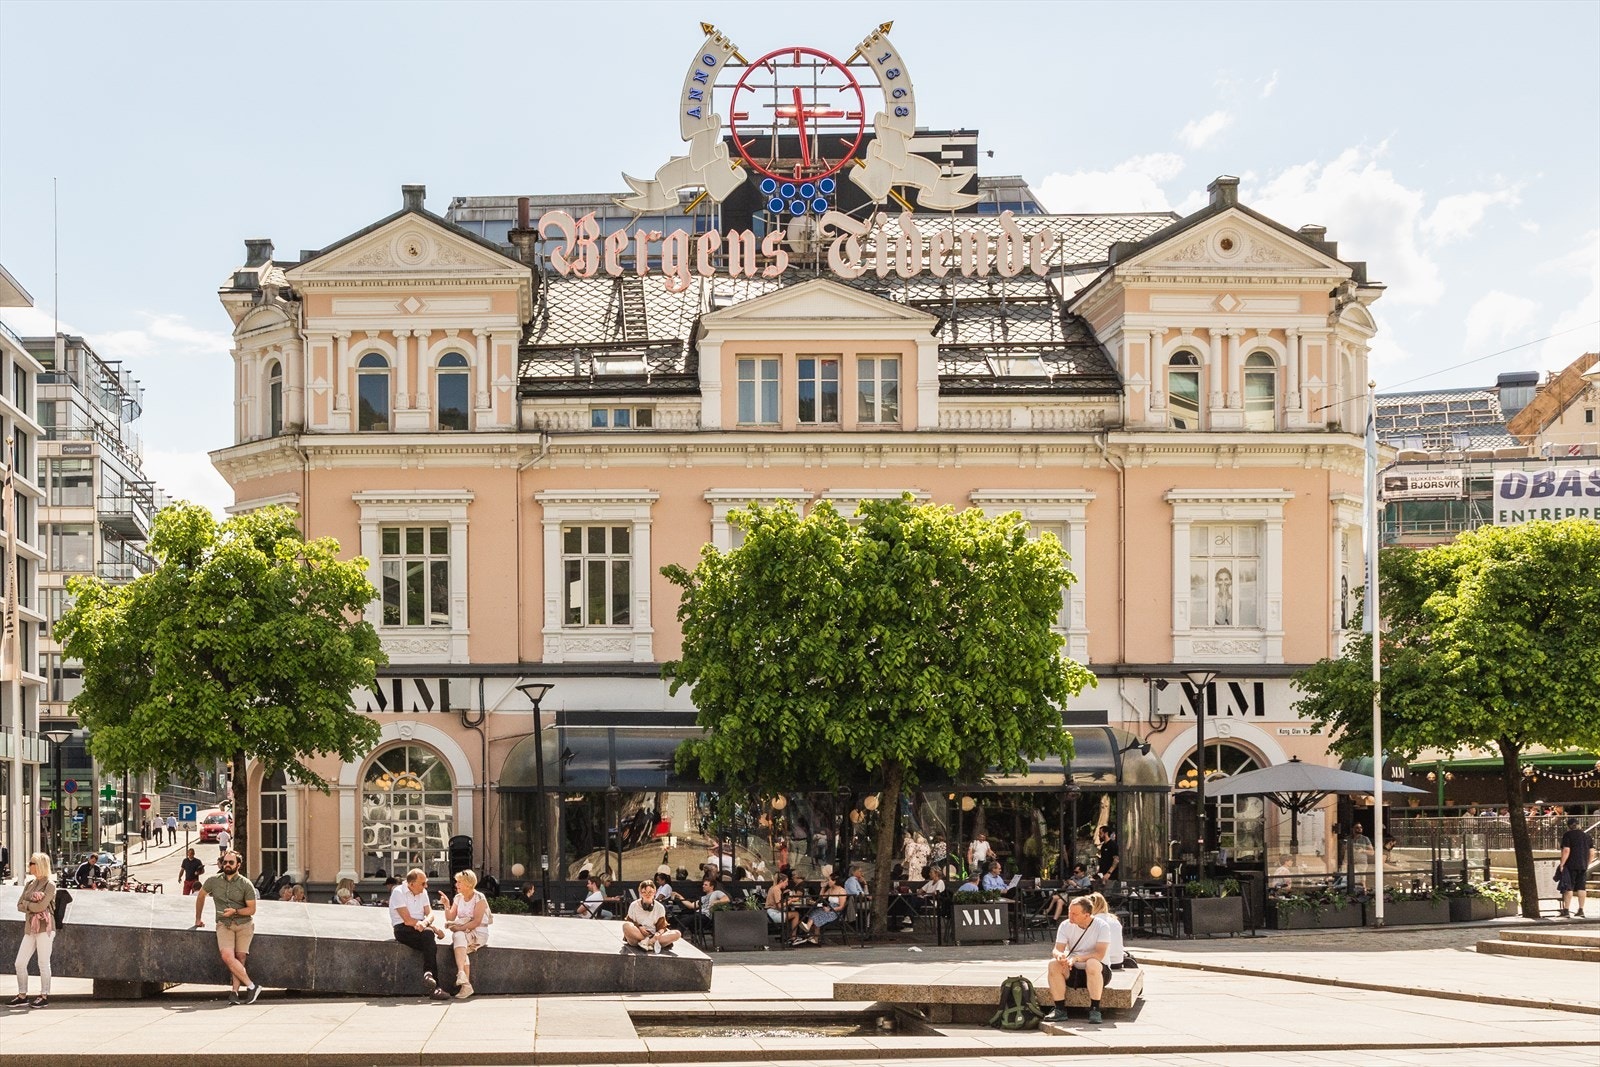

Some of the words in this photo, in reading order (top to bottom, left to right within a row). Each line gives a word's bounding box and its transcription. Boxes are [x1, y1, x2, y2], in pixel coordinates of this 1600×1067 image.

[687, 53, 717, 119] ANNO
[877, 52, 910, 117] 1868
[538, 210, 788, 293] Bergens
[820, 209, 1054, 279] Tidende
[1500, 508, 1600, 522] ENTREPRE
[366, 679, 450, 712] MM
[1180, 682, 1265, 716] MM
[1391, 766, 1405, 778] MM
[182, 805, 193, 819] P
[962, 909, 1001, 926] MM
